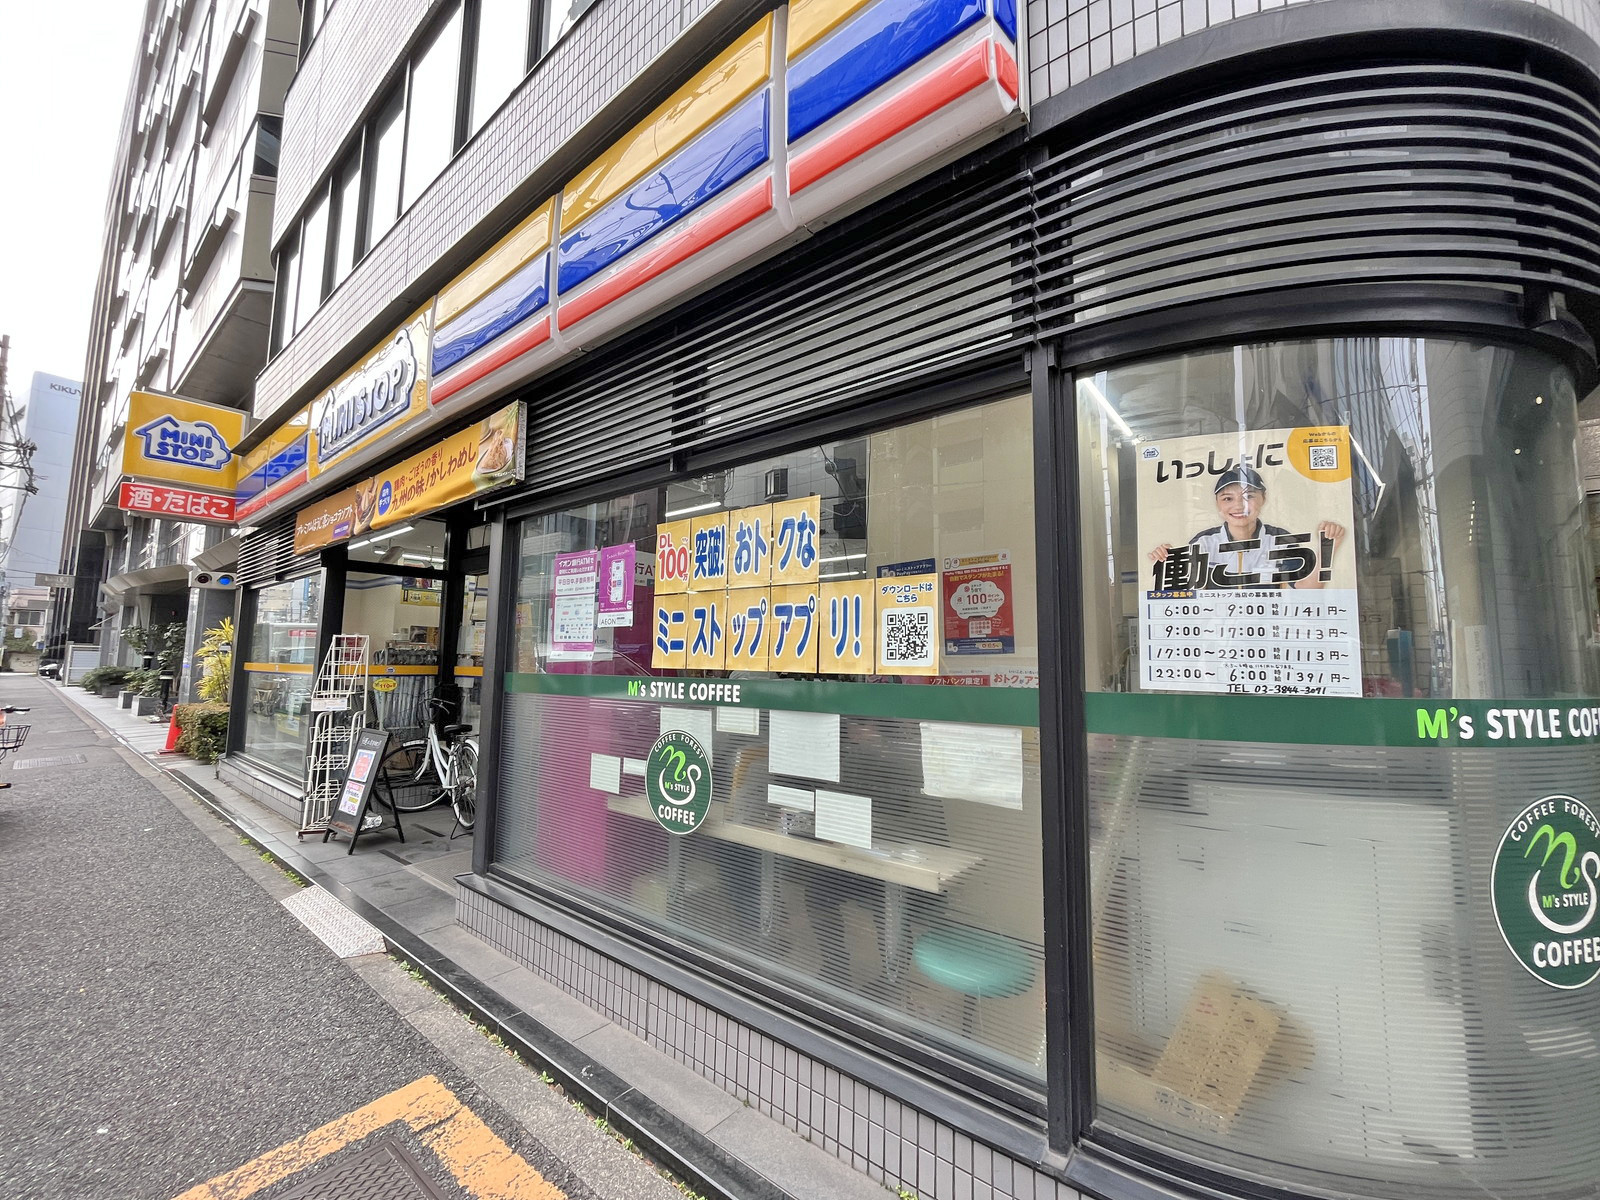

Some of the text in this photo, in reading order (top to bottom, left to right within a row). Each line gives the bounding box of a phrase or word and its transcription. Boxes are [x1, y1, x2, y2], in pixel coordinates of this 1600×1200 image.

[160, 427, 213, 449] MINI
[157, 442, 214, 462] STOP
[128, 485, 229, 518] 酒・たばこ
[659, 533, 673, 549] DL
[1152, 532, 1334, 590] 働こう!
[881, 582, 933, 595] ダウンロードは
[896, 593, 918, 603] こちら
[966, 593, 987, 605] 100
[628, 680, 741, 703] M's STYLE COFFEE
[1227, 684, 1249, 693] TEL
[1416, 706, 1600, 740] M's STYLE COF
[654, 734, 705, 759] COFFEE FOREST
[674, 783, 690, 794] STYLE
[658, 804, 696, 826] COFFEE
[1510, 801, 1556, 842] COFFEE
[1562, 892, 1589, 908] STYLE
[1533, 936, 1600, 968] COFFEE
